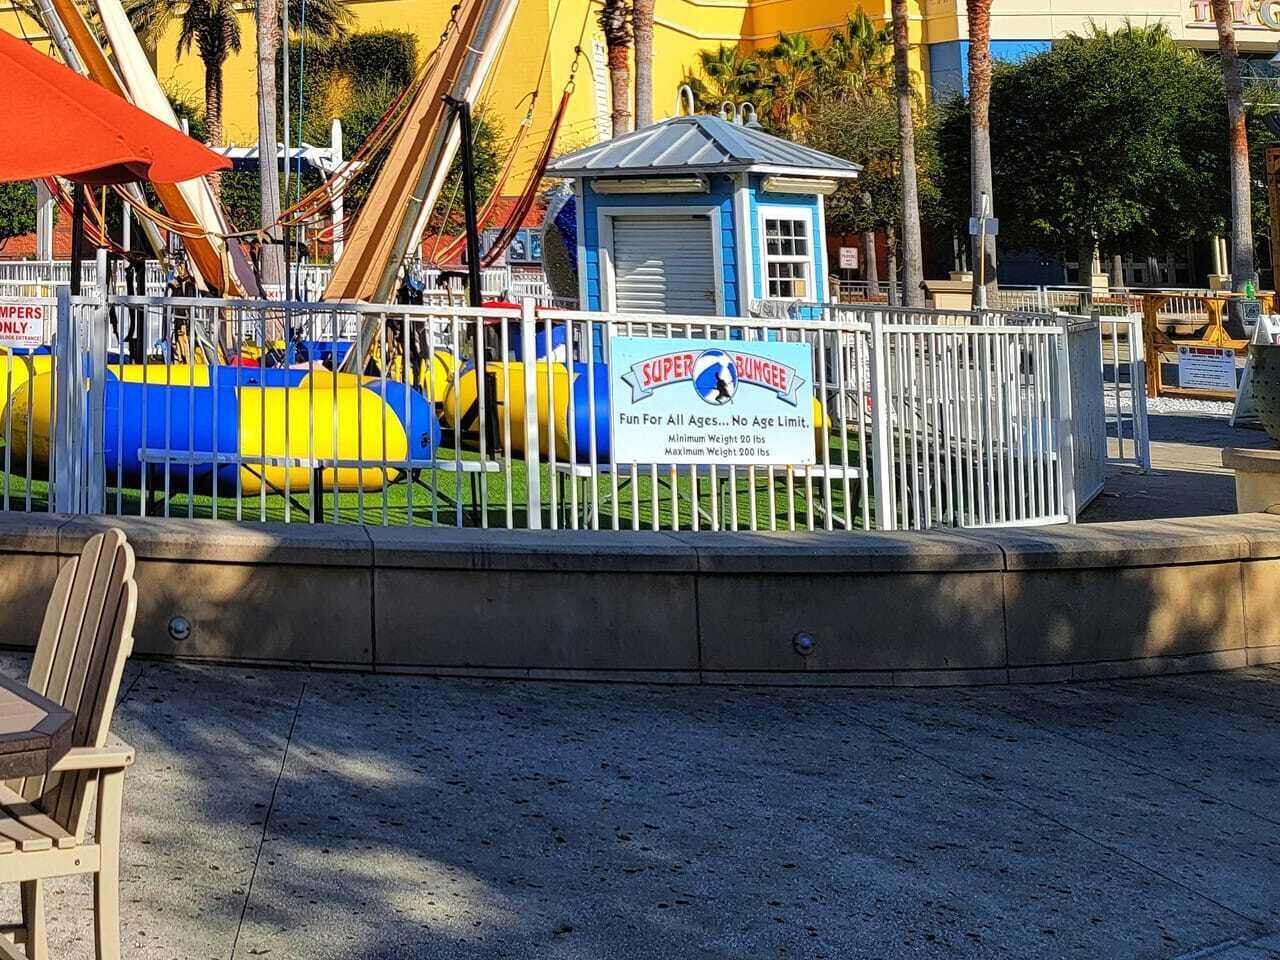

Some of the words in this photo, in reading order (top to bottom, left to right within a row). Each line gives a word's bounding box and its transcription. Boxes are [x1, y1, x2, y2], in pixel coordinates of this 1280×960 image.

[642, 354, 693, 386] SUPER
[736, 355, 787, 391] BUNGEE
[619, 413, 640, 425] Fun
[643, 413, 662, 425] For
[667, 414, 684, 426] All
[732, 416, 748, 427] No
[752, 416, 774, 429] Age
[777, 416, 810, 429] Limit.
[668, 434, 705, 443] Minimum
[708, 434, 738, 445] Weight
[740, 435, 751, 443] 20
[753, 435, 766, 444] lbs
[664, 447, 705, 456] Maximum
[706, 447, 737, 457] Weight
[739, 448, 755, 456] 200
[757, 448, 770, 457] lbs
